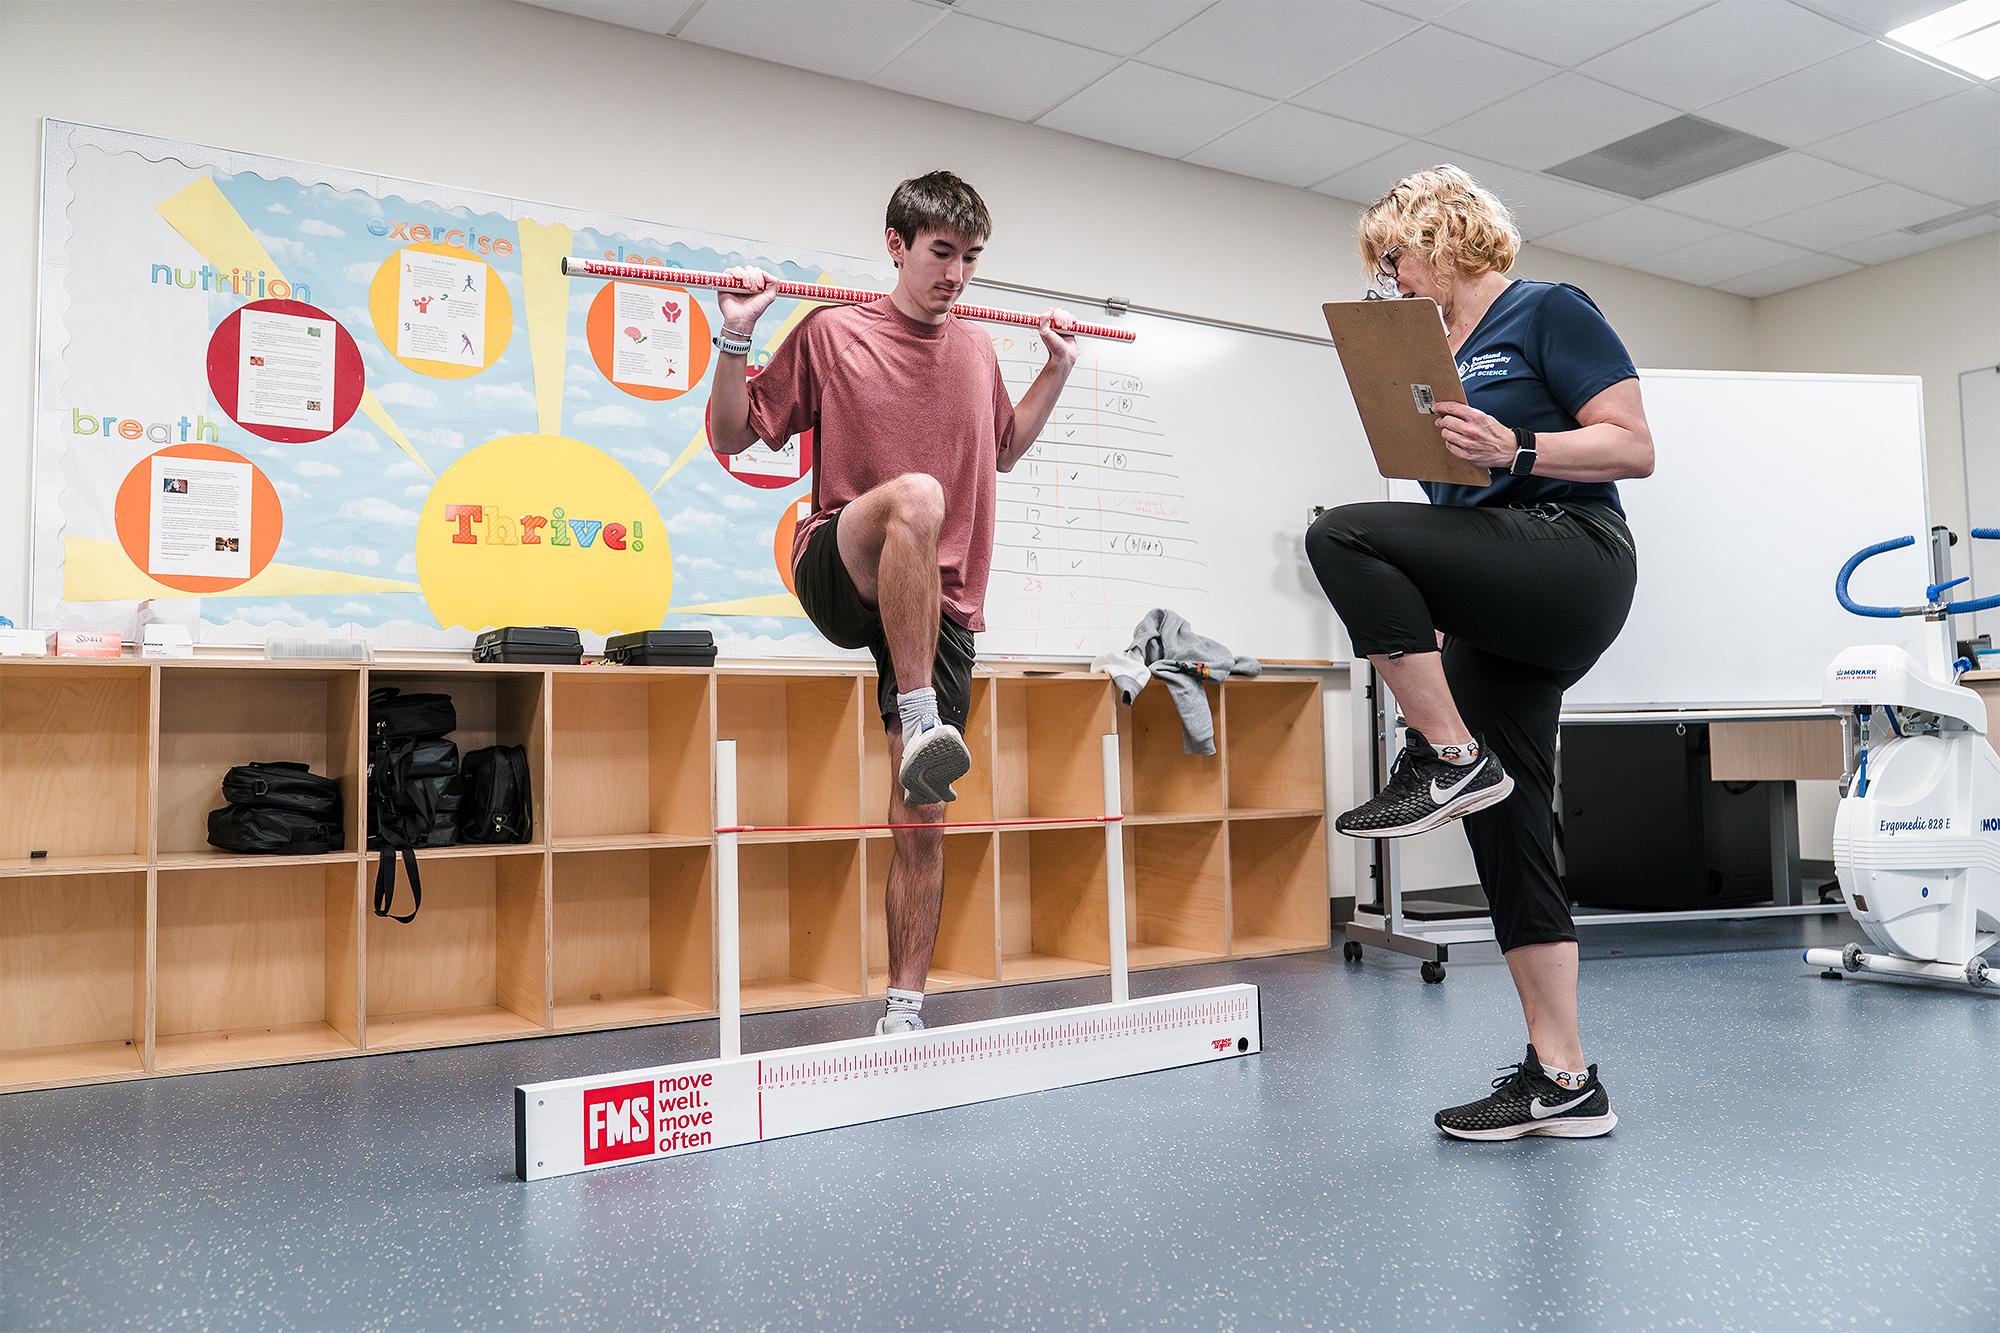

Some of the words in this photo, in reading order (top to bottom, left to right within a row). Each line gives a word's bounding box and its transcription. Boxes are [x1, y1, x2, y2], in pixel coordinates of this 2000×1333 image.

[367, 217, 513, 257] exercise
[405, 264, 412, 272] 1
[151, 264, 311, 303] nutrition
[404, 322, 411, 331] 3
[73, 408, 218, 444] breath
[1032, 487, 1041, 498] 7
[445, 504, 644, 552] Thrive!
[1032, 526, 1042, 540] 2
[1026, 550, 1038, 572] 19
[1024, 576, 1043, 592] 23
[1880, 816, 1928, 836] Ergomedic
[1928, 818, 1944, 830] 828
[1946, 818, 1952, 829] E
[659, 1073, 713, 1093] move
[659, 1090, 709, 1113] well.
[589, 1096, 650, 1150] FMS
[659, 1111, 713, 1132] move
[659, 1131, 712, 1152] often
